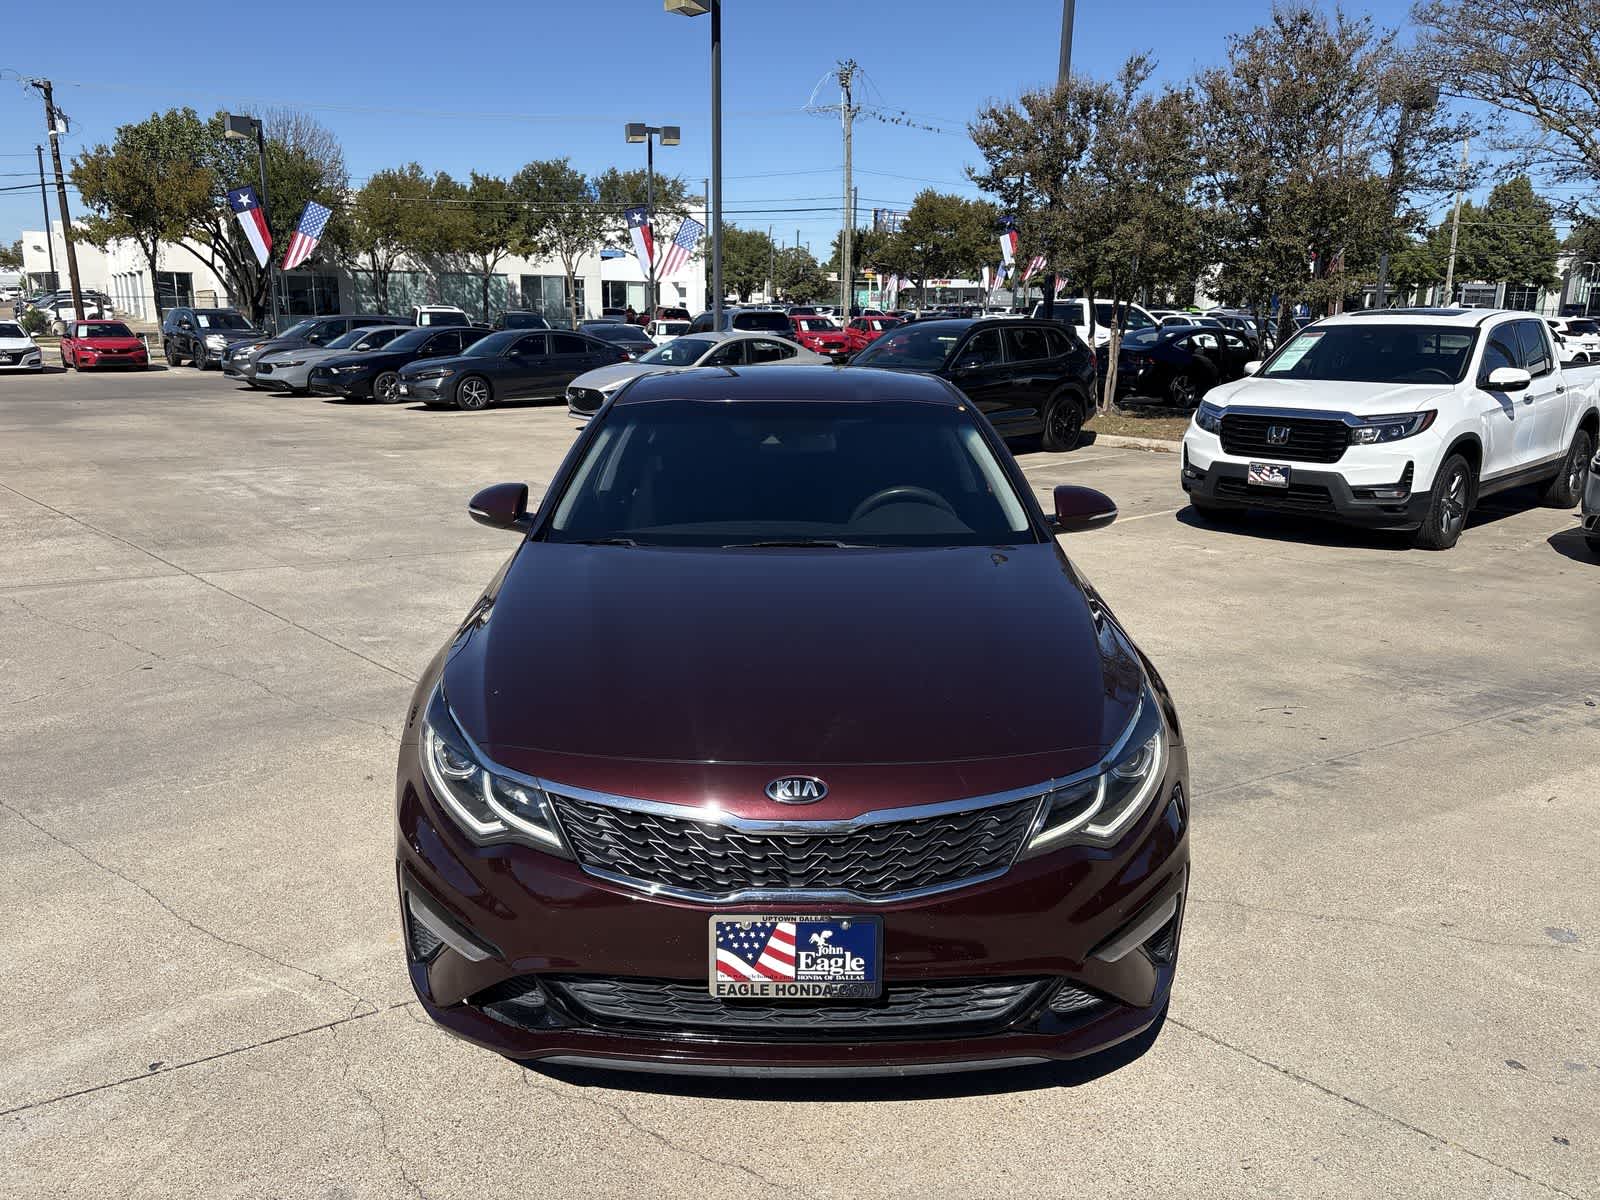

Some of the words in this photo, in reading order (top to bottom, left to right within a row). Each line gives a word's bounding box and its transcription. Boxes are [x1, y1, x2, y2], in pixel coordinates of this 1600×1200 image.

[776, 780, 819, 797] KIA
[797, 952, 865, 976] Eagle
[716, 983, 770, 996] EAGLE
